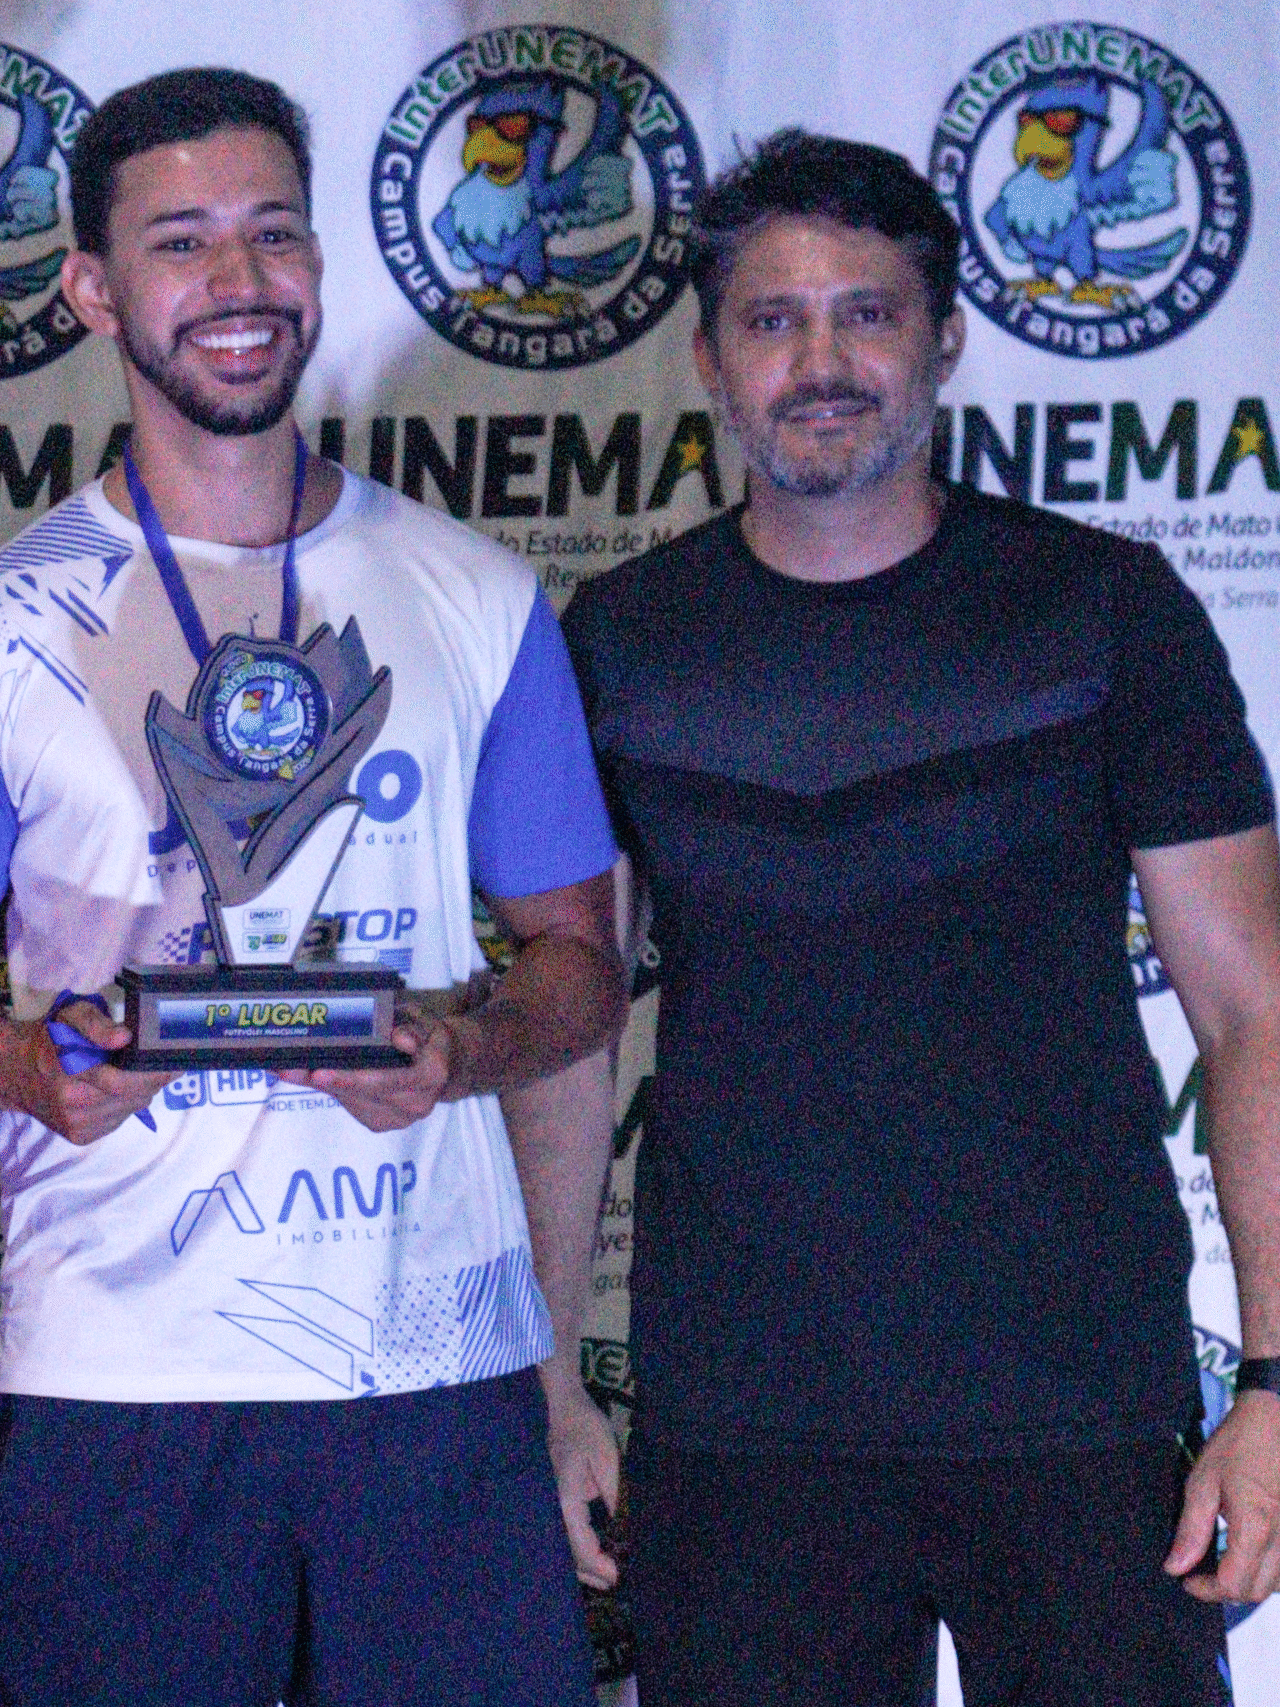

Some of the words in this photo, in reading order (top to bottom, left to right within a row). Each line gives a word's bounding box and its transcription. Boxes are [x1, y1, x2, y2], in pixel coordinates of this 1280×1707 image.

[1207, 511, 1272, 538] Mato
[526, 529, 607, 557] Estado
[1183, 544, 1280, 573] Maldon
[237, 1001, 329, 1028] LUGAR
